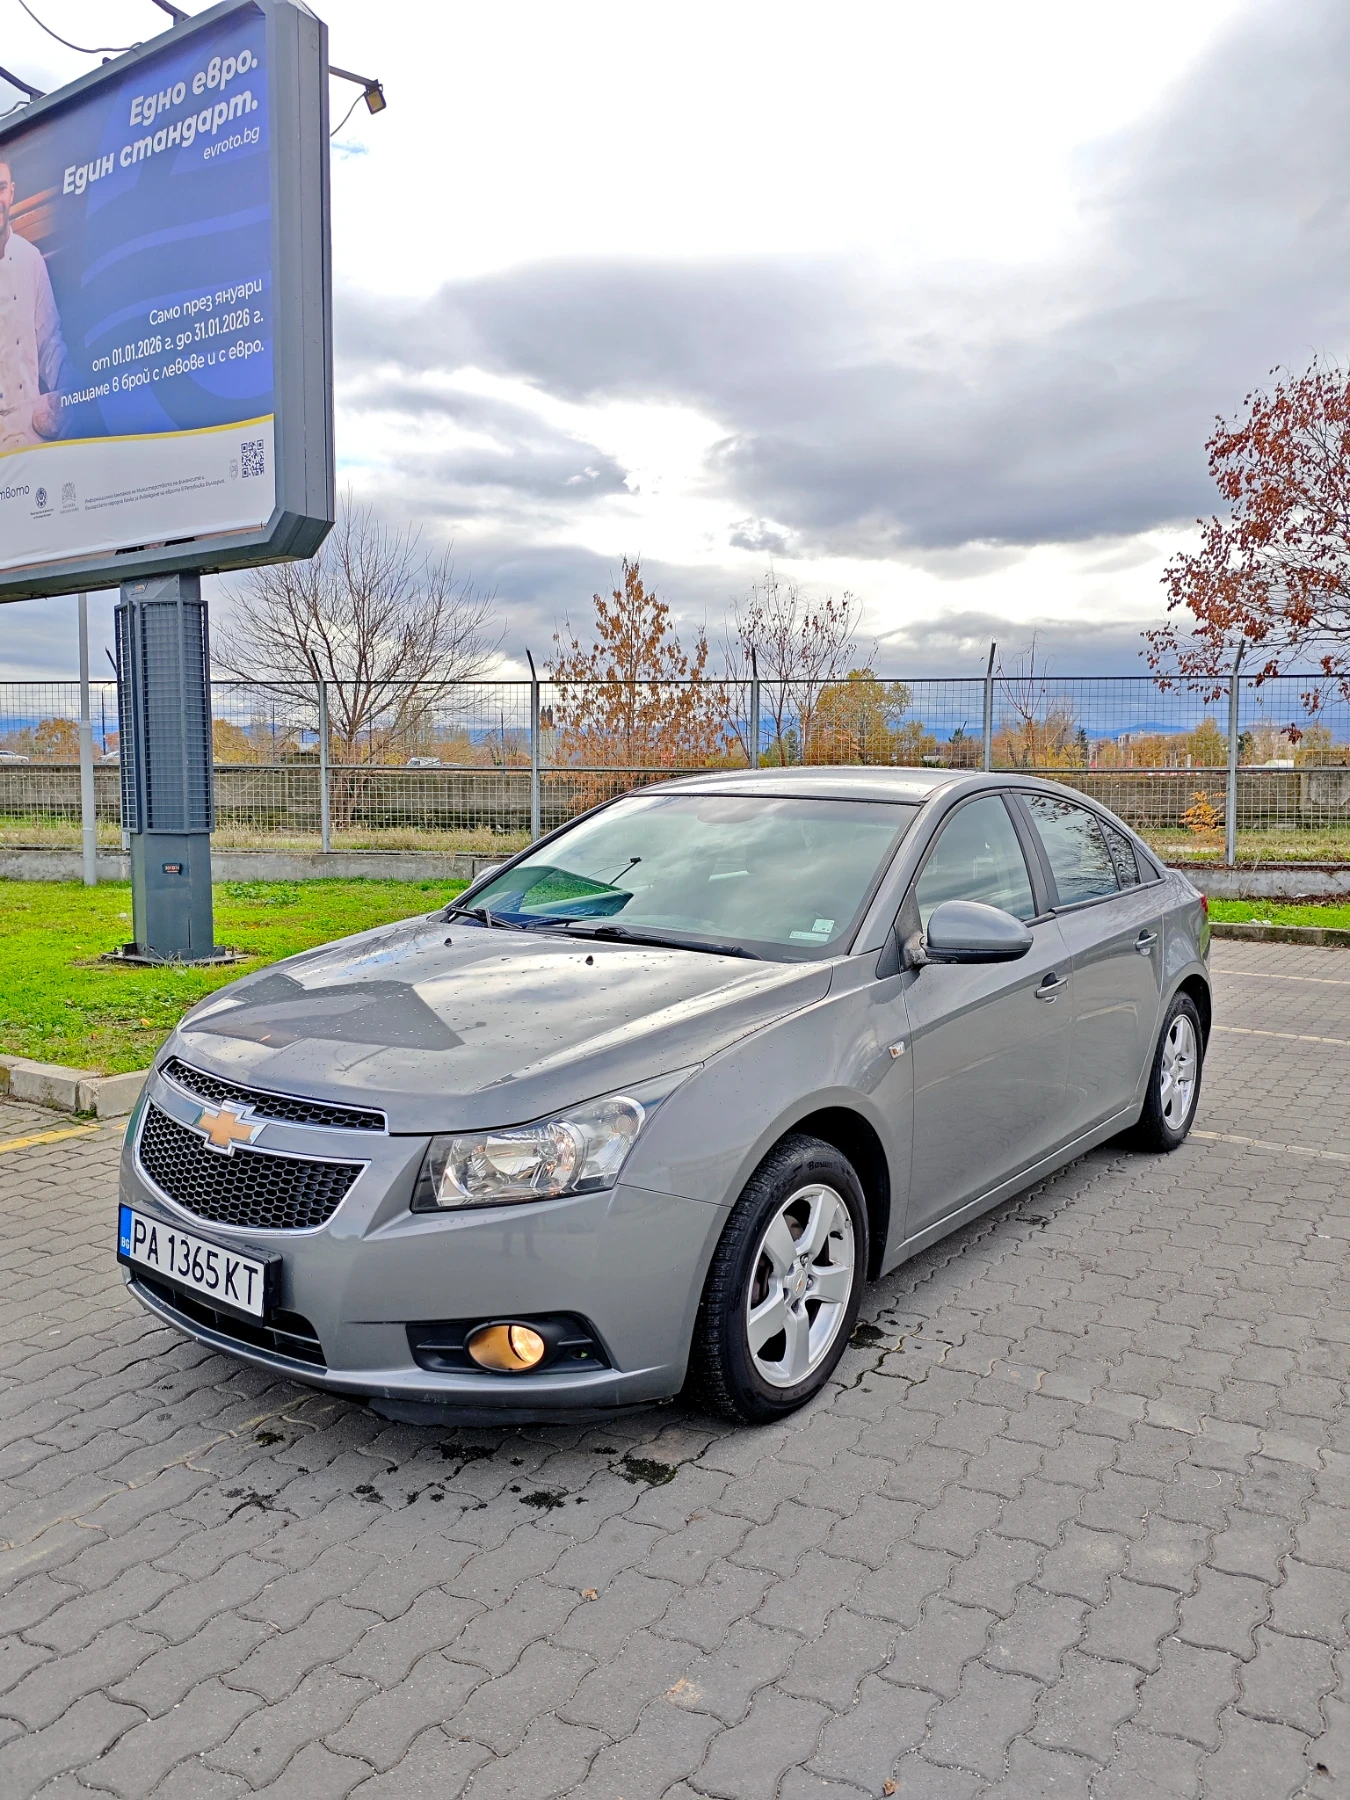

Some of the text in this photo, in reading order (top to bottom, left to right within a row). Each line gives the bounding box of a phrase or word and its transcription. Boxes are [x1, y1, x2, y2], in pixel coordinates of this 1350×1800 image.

[129, 49, 258, 127] Едно евро.
[62, 89, 258, 195] Един стандарт.
[203, 125, 260, 160] evroto.bg
[149, 278, 262, 326] Само през януари
[92, 309, 264, 372] от 01.01.2026 г. до 31.01.2026 г.
[60, 338, 265, 408] плащаме в брой с левове и с евро.
[121, 1237, 130, 1249] BG
